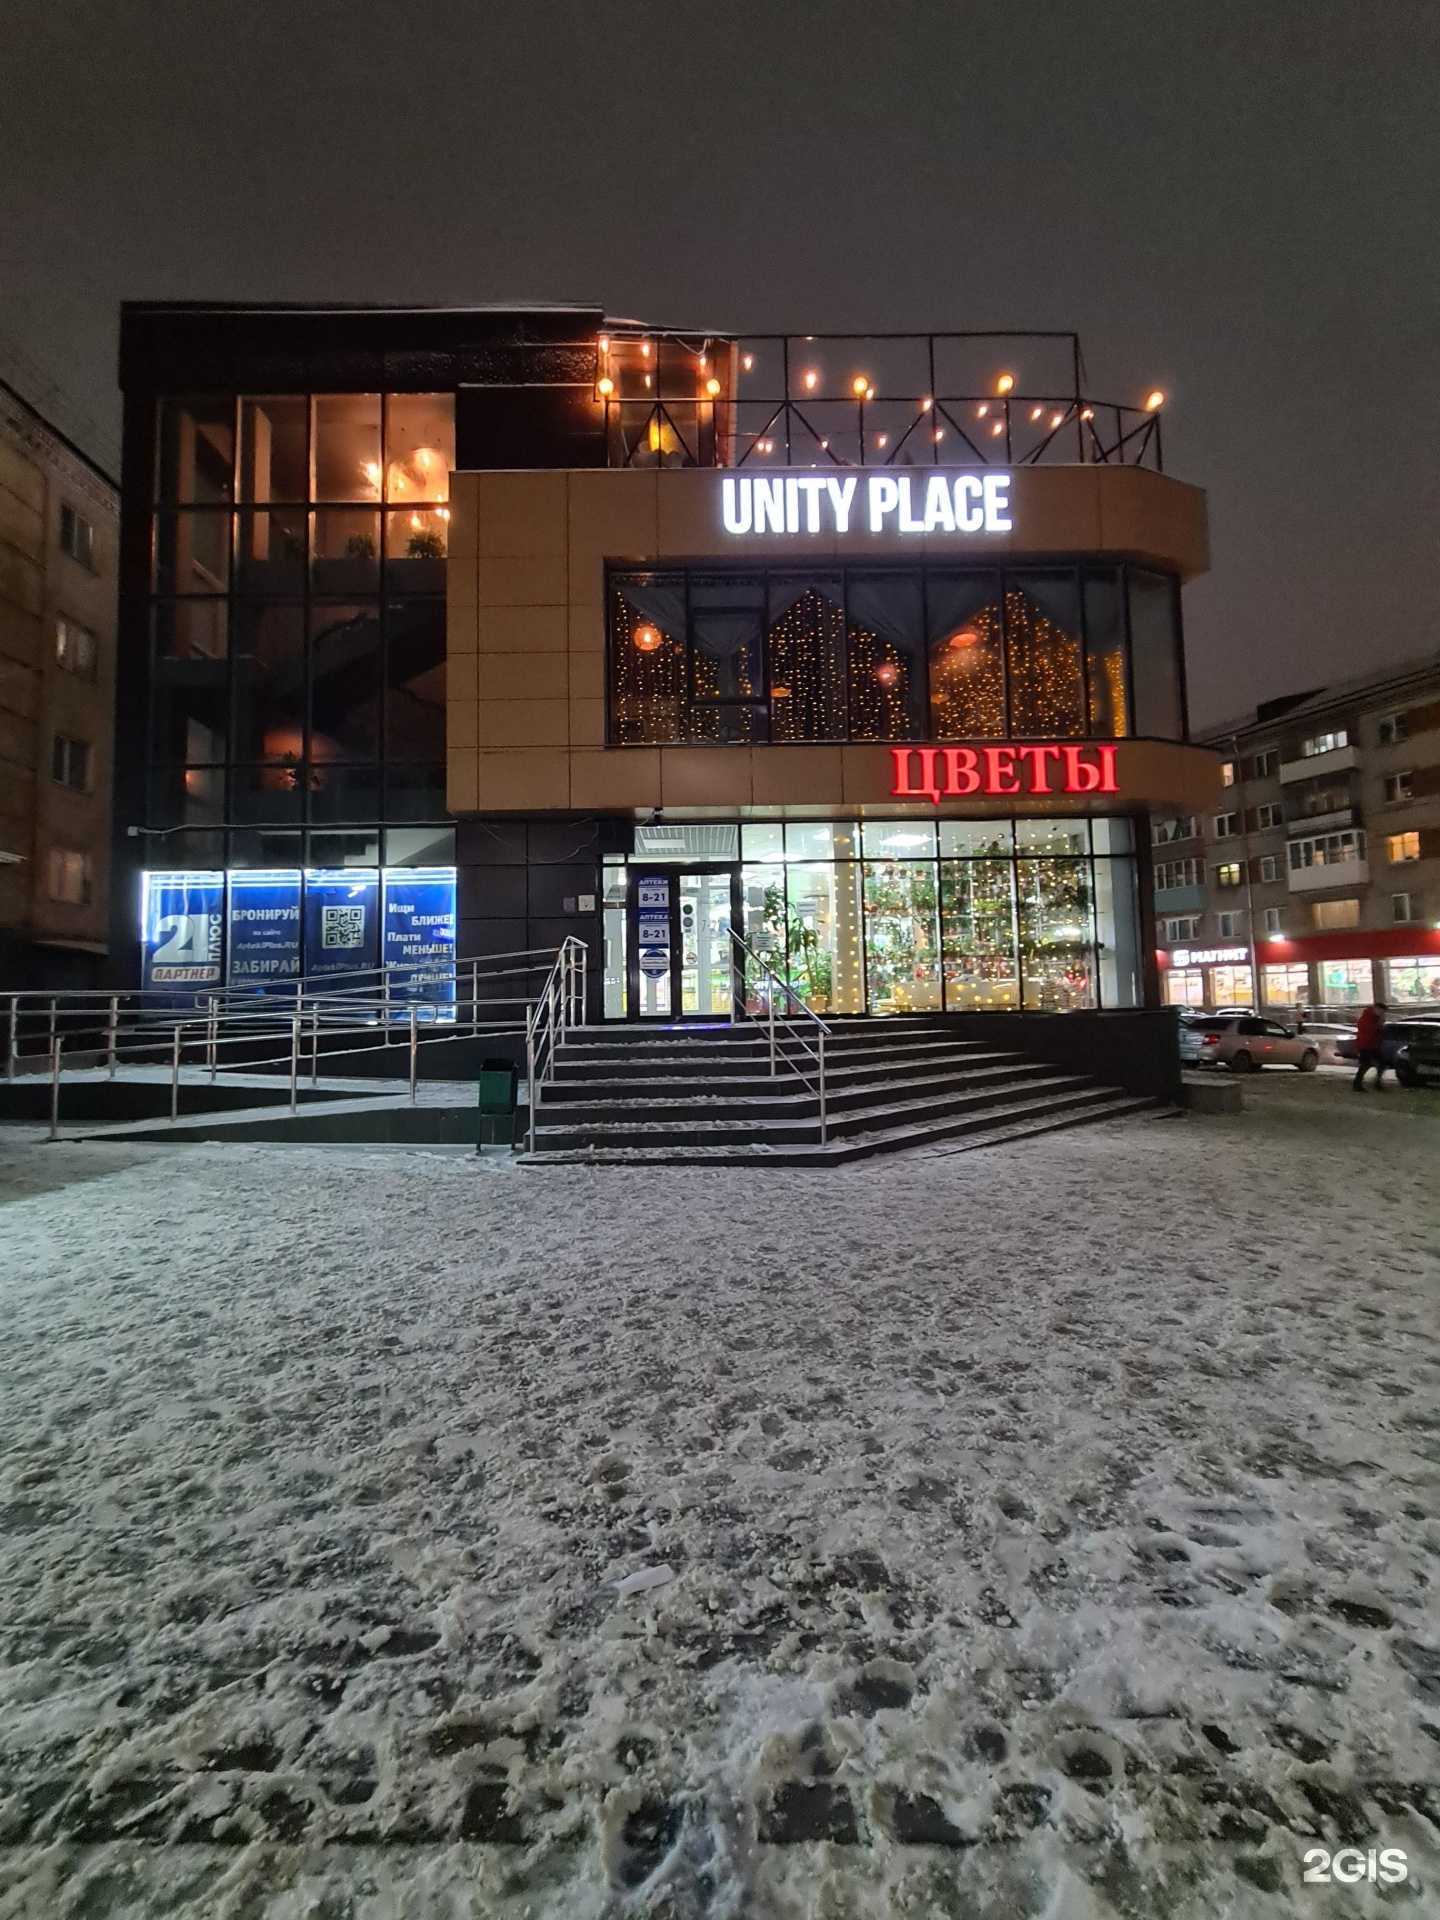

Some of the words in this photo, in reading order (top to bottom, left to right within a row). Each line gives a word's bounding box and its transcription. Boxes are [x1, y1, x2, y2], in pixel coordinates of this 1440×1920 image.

[722, 476, 857, 534] UNITY
[868, 474, 1014, 534] PLACE
[890, 745, 1120, 804] ЦВЕТЫ
[642, 893, 666, 902] 8-21
[232, 906, 300, 921] БРОНИРУЙ
[389, 903, 415, 914] Ищи
[208, 913, 222, 962] ПЛЮС
[387, 931, 421, 942] Плати
[642, 929, 666, 938] 8-21
[403, 943, 453, 955] МЕНЬШЕ!
[232, 957, 300, 973] ЗАБИРАЙ
[153, 968, 217, 980] ПАРТНЕР
